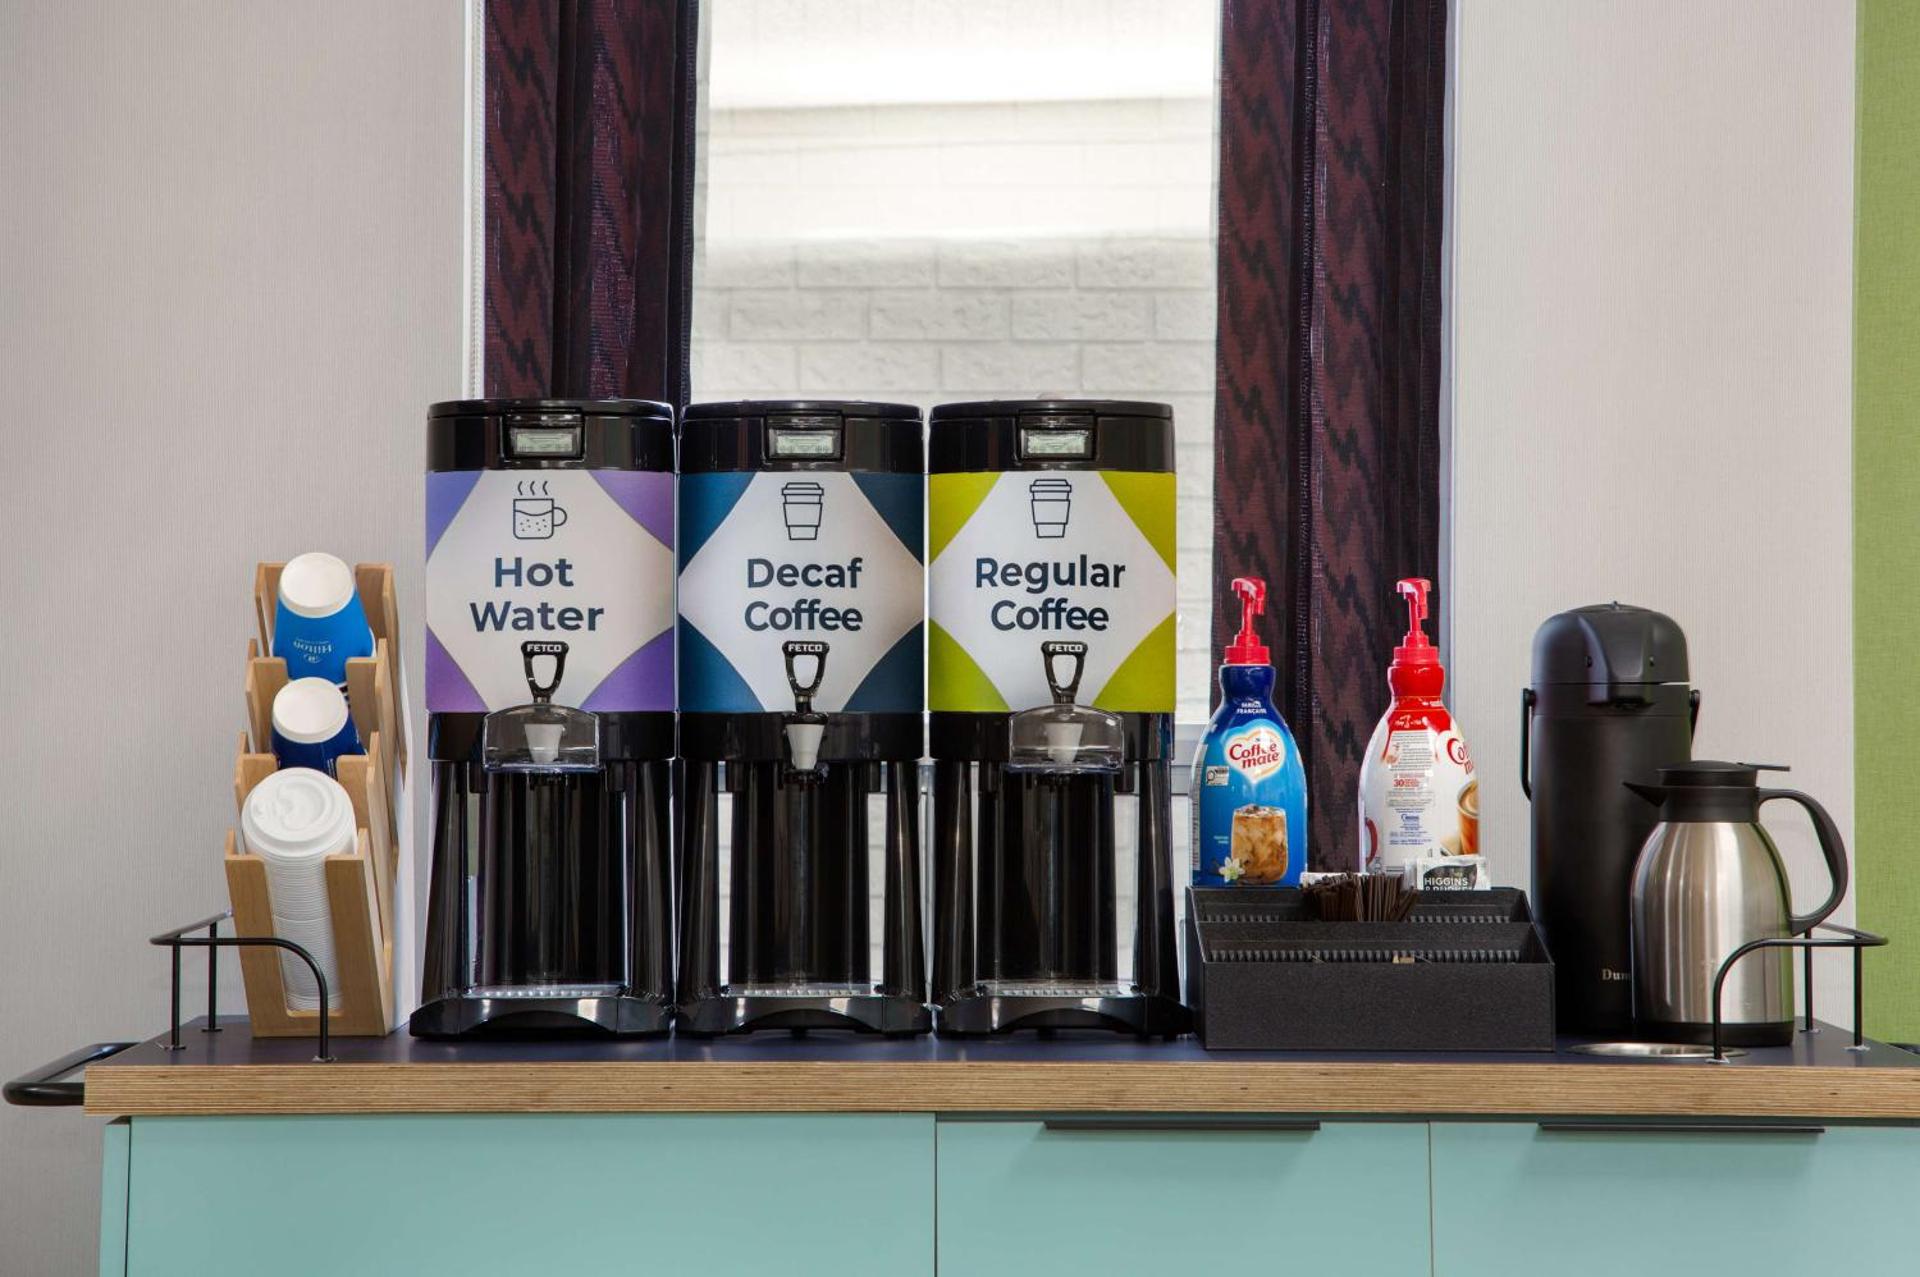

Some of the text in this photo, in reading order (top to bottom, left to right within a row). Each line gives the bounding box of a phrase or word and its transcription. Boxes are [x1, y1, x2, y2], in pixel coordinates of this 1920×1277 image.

[494, 556, 575, 588] Hot
[747, 556, 864, 589] Decaf
[976, 554, 1126, 593] Regular
[469, 600, 605, 633] Water
[744, 598, 864, 632] Coffee
[990, 598, 1110, 632] Coffee
[527, 643, 562, 653] FETCO
[787, 643, 823, 653] FETCO
[1048, 643, 1083, 653] FETCO
[1229, 743, 1277, 760] Coffe
[1241, 752, 1280, 769] mate
[1424, 877, 1468, 886] HIGGINS
